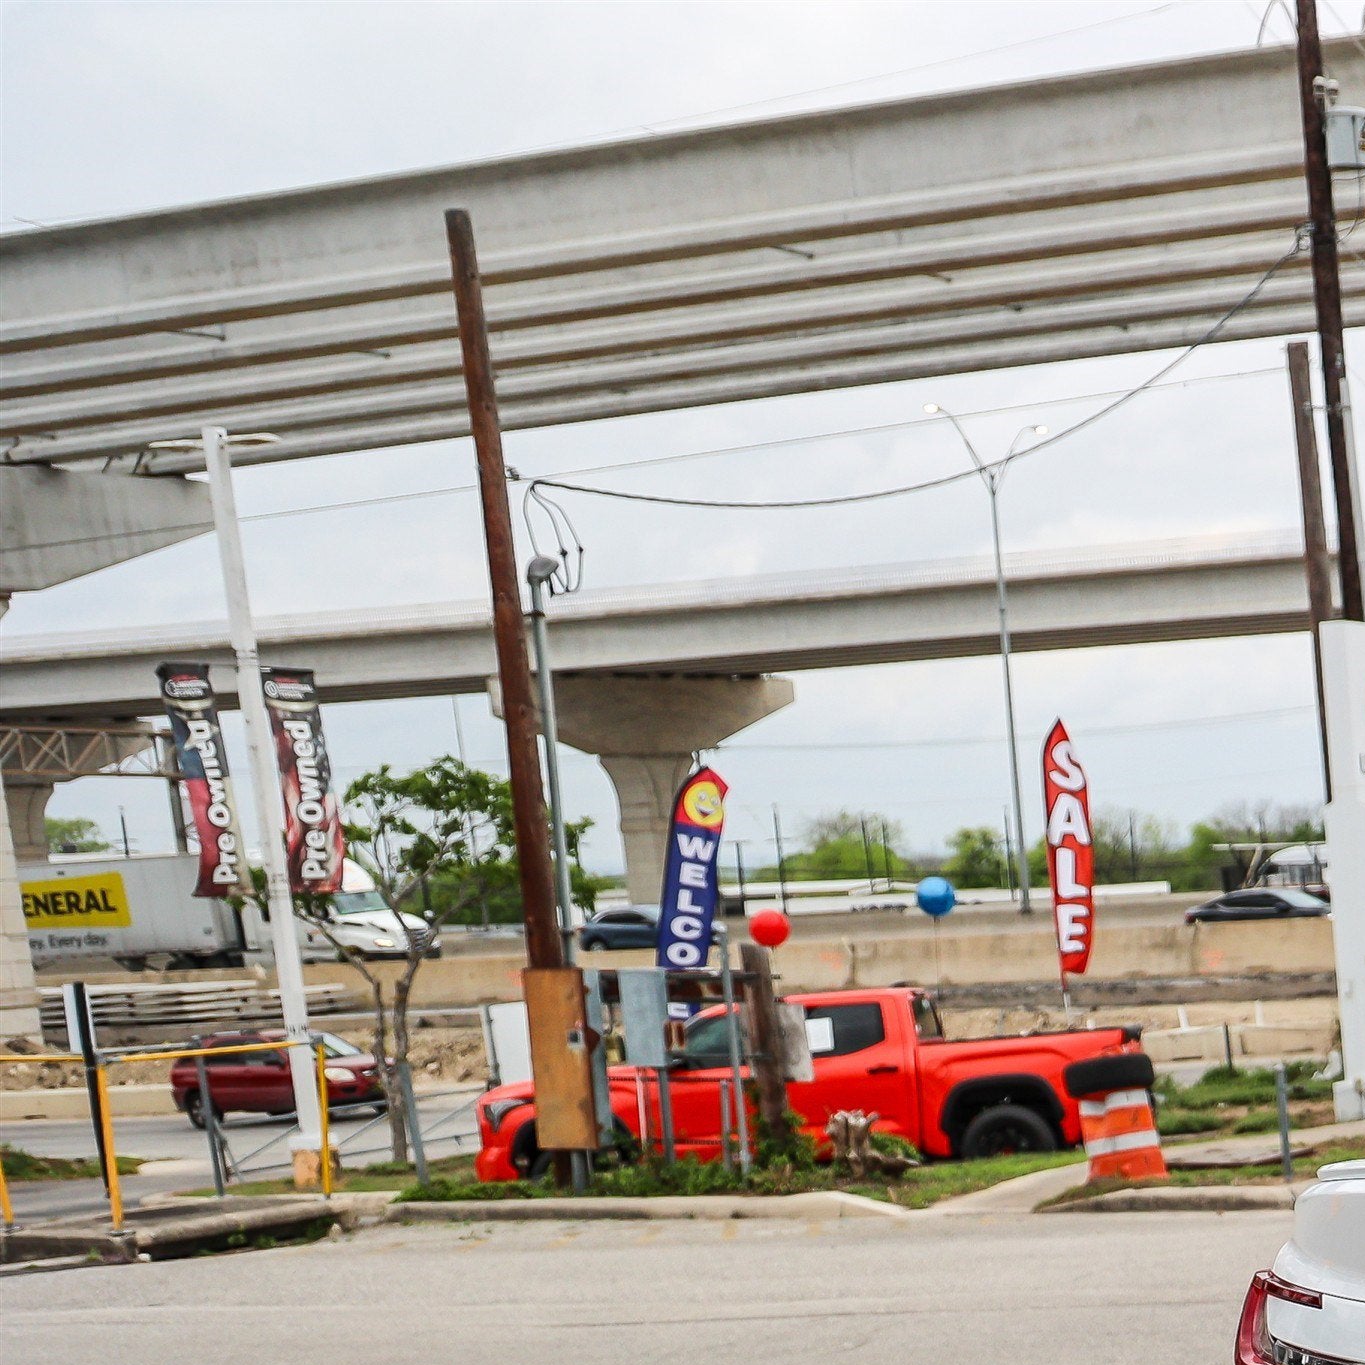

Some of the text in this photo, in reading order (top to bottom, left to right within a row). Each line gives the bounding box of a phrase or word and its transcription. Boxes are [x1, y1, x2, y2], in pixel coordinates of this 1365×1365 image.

[187, 720, 231, 828] Owned
[283, 720, 327, 880] Pre Owned
[22, 888, 118, 918] ENERAL
[213, 832, 240, 884] Pre
[1048, 740, 1092, 952] SALE
[666, 832, 716, 1019] WELCOE
